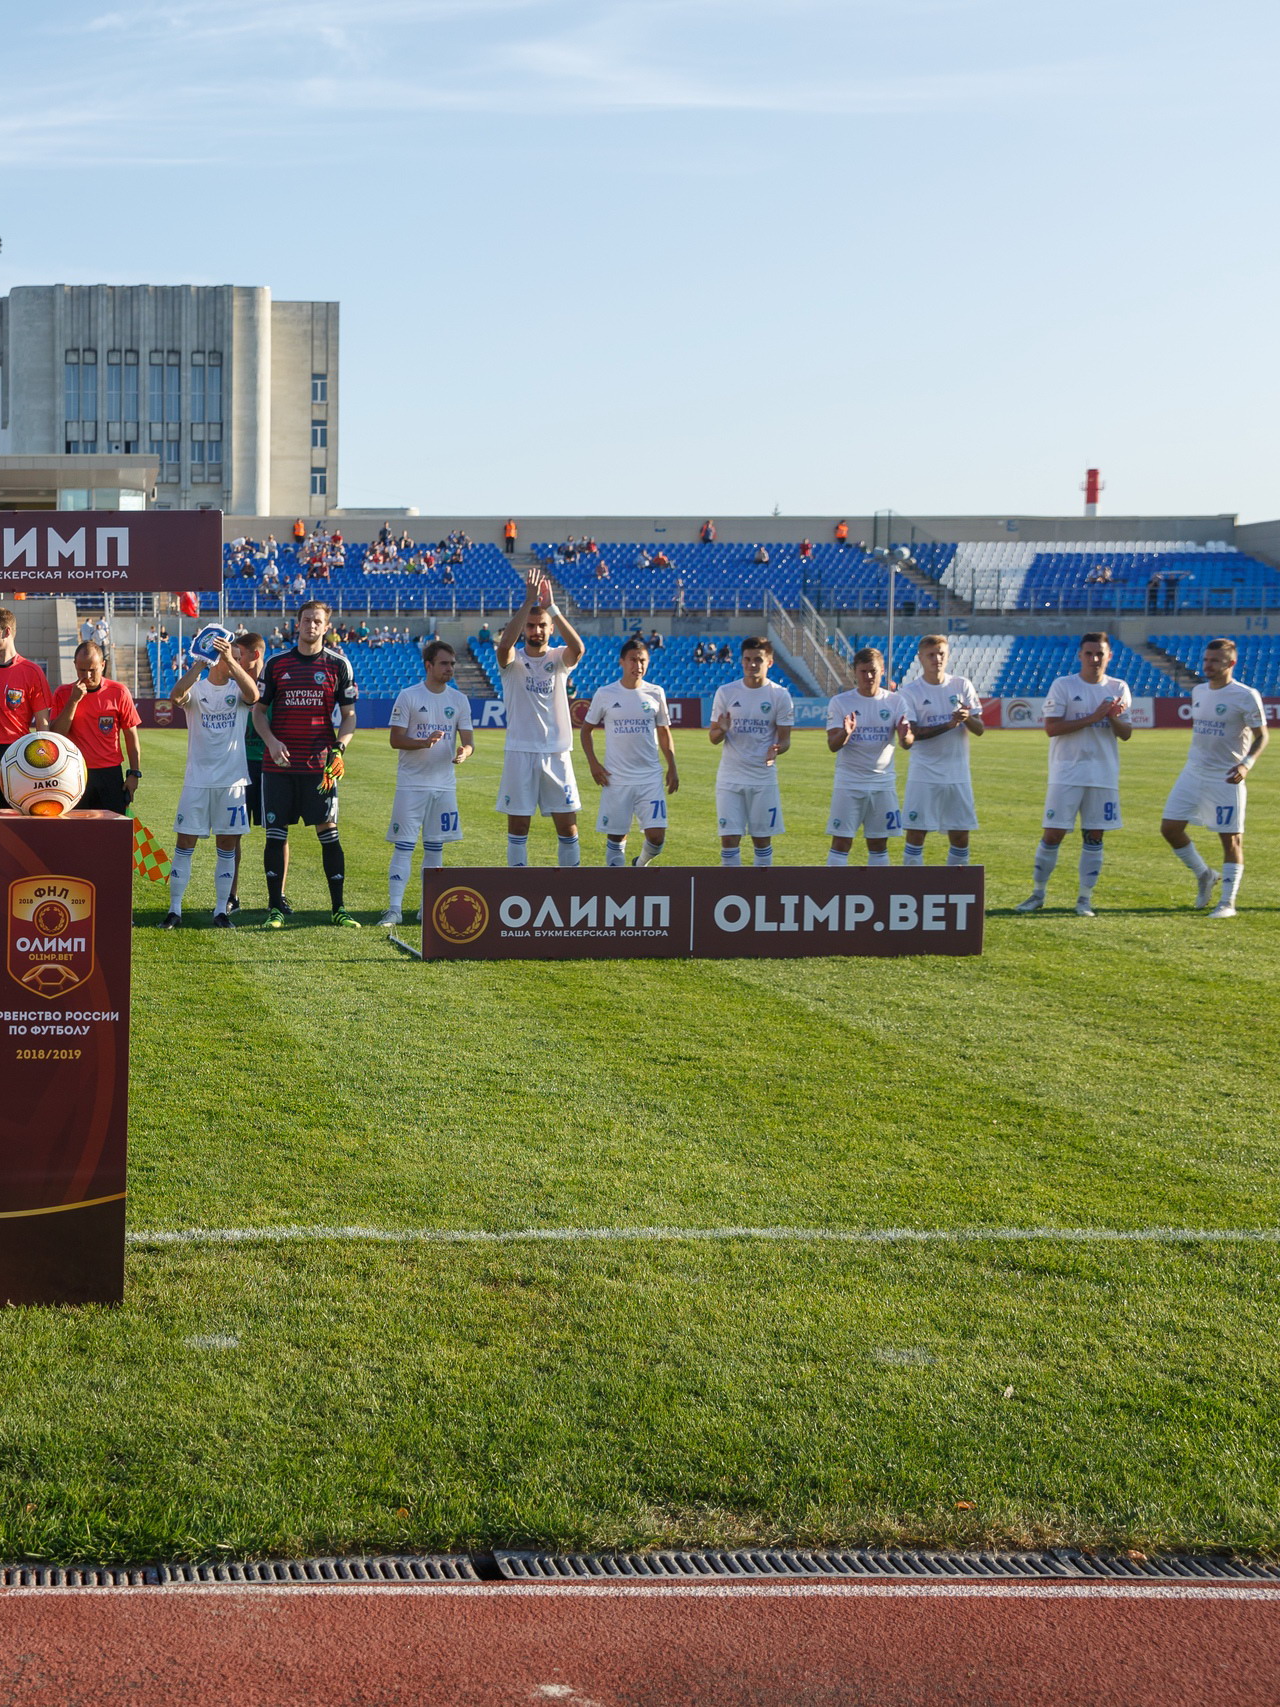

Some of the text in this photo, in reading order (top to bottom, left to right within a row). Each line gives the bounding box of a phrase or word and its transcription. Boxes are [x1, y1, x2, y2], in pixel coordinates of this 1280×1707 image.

[67, 570, 129, 579] КОНТОРА
[284, 689, 325, 698] КУРСКАЯ
[284, 698, 324, 706] ОБЛАСТЬ
[416, 722, 453, 733] КУРСКАЯ
[613, 719, 652, 727] КУРСКАЯ
[613, 725, 651, 734] ОБЛАСТЬ
[854, 726, 891, 734] УРСКАЯ
[33, 779, 59, 790] JAKO
[227, 805, 246, 827] 71
[768, 807, 777, 828] 7
[440, 811, 459, 832] 97
[34, 885, 70, 900] ФНЛ
[499, 895, 670, 928] ОЛИМП
[714, 895, 976, 933] OLIMP.BET
[534, 929, 617, 937] БУКМЕКЕРСКАЯ
[620, 929, 669, 937] КОНТОРА
[16, 937, 86, 952] ОЛИМП
[28, 953, 74, 961] OLIMP.BET
[65, 1011, 119, 1021] РОССИИ
[8, 1025, 91, 1035] ПО ФУТБОЛУ
[16, 1049, 82, 1060] 2018/2019
